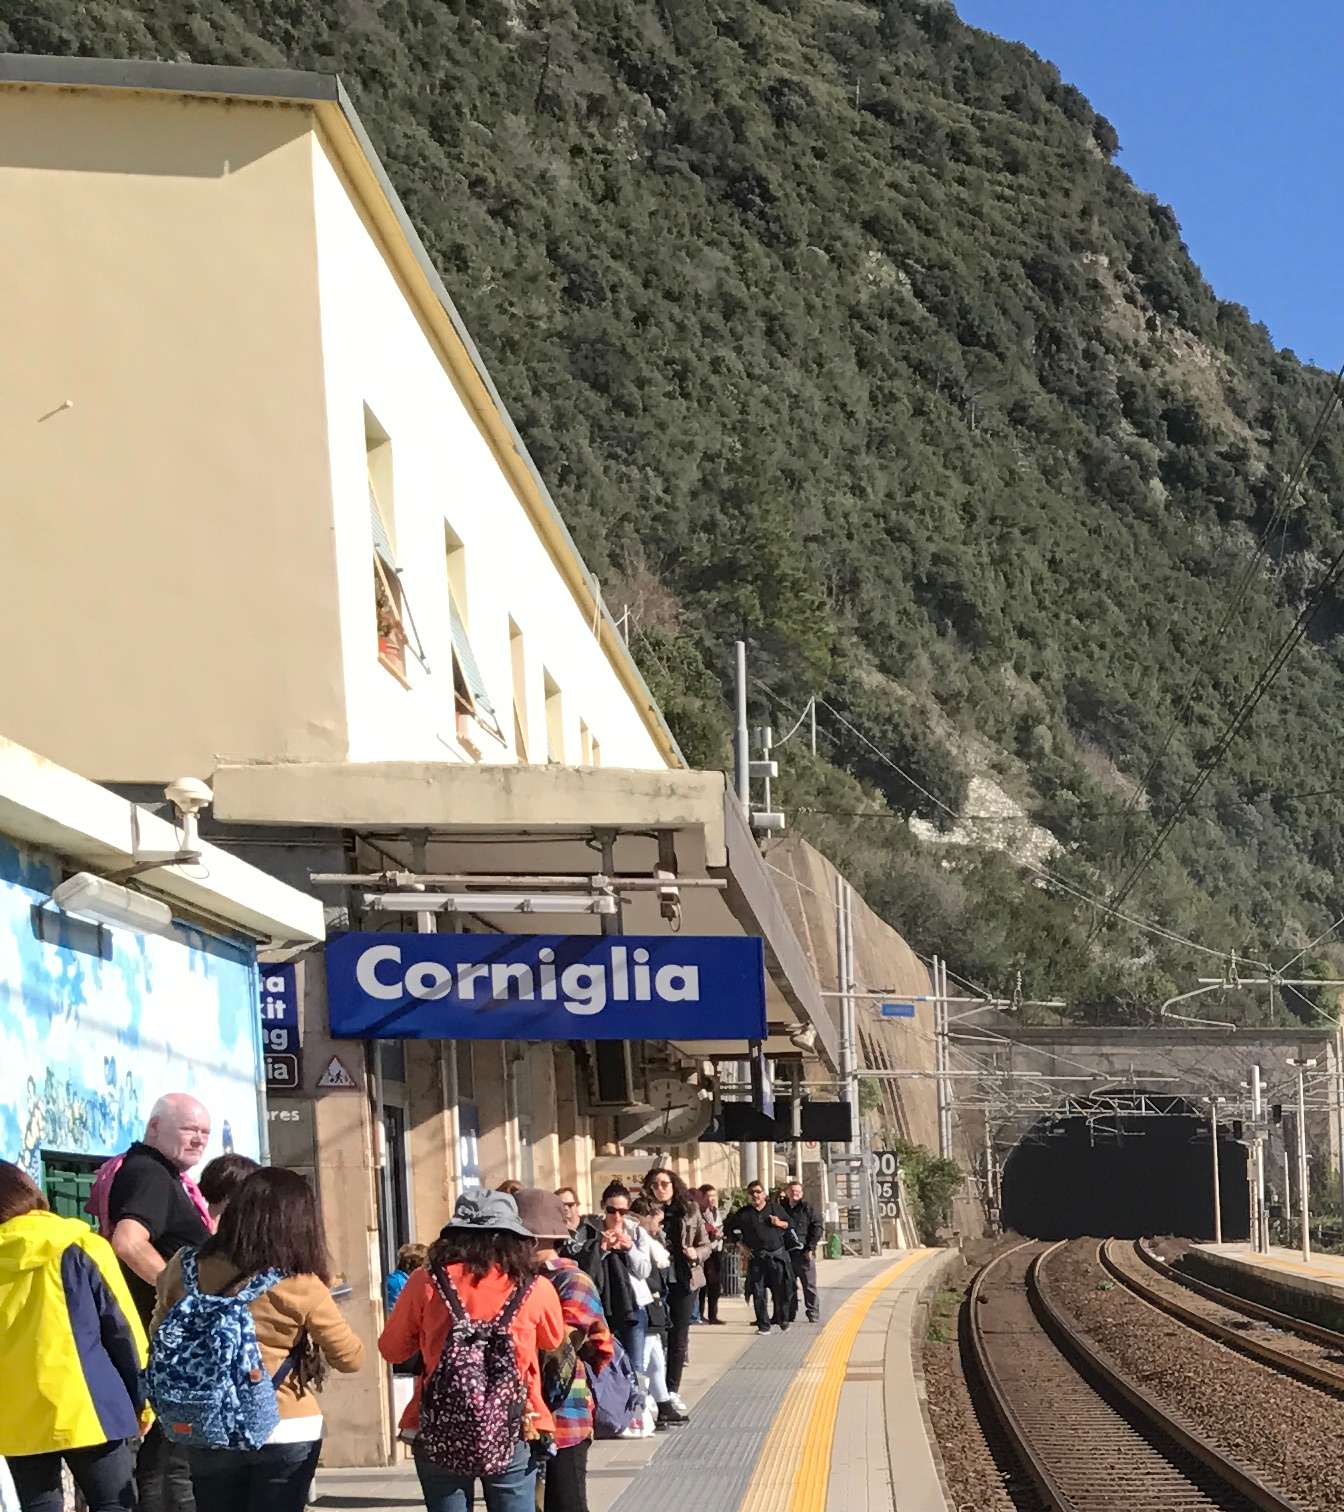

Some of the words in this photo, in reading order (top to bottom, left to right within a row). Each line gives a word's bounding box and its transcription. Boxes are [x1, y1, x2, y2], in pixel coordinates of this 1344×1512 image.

[260, 975, 285, 993] a
[355, 944, 700, 1015] Corniglia
[267, 1057, 289, 1080] ia
